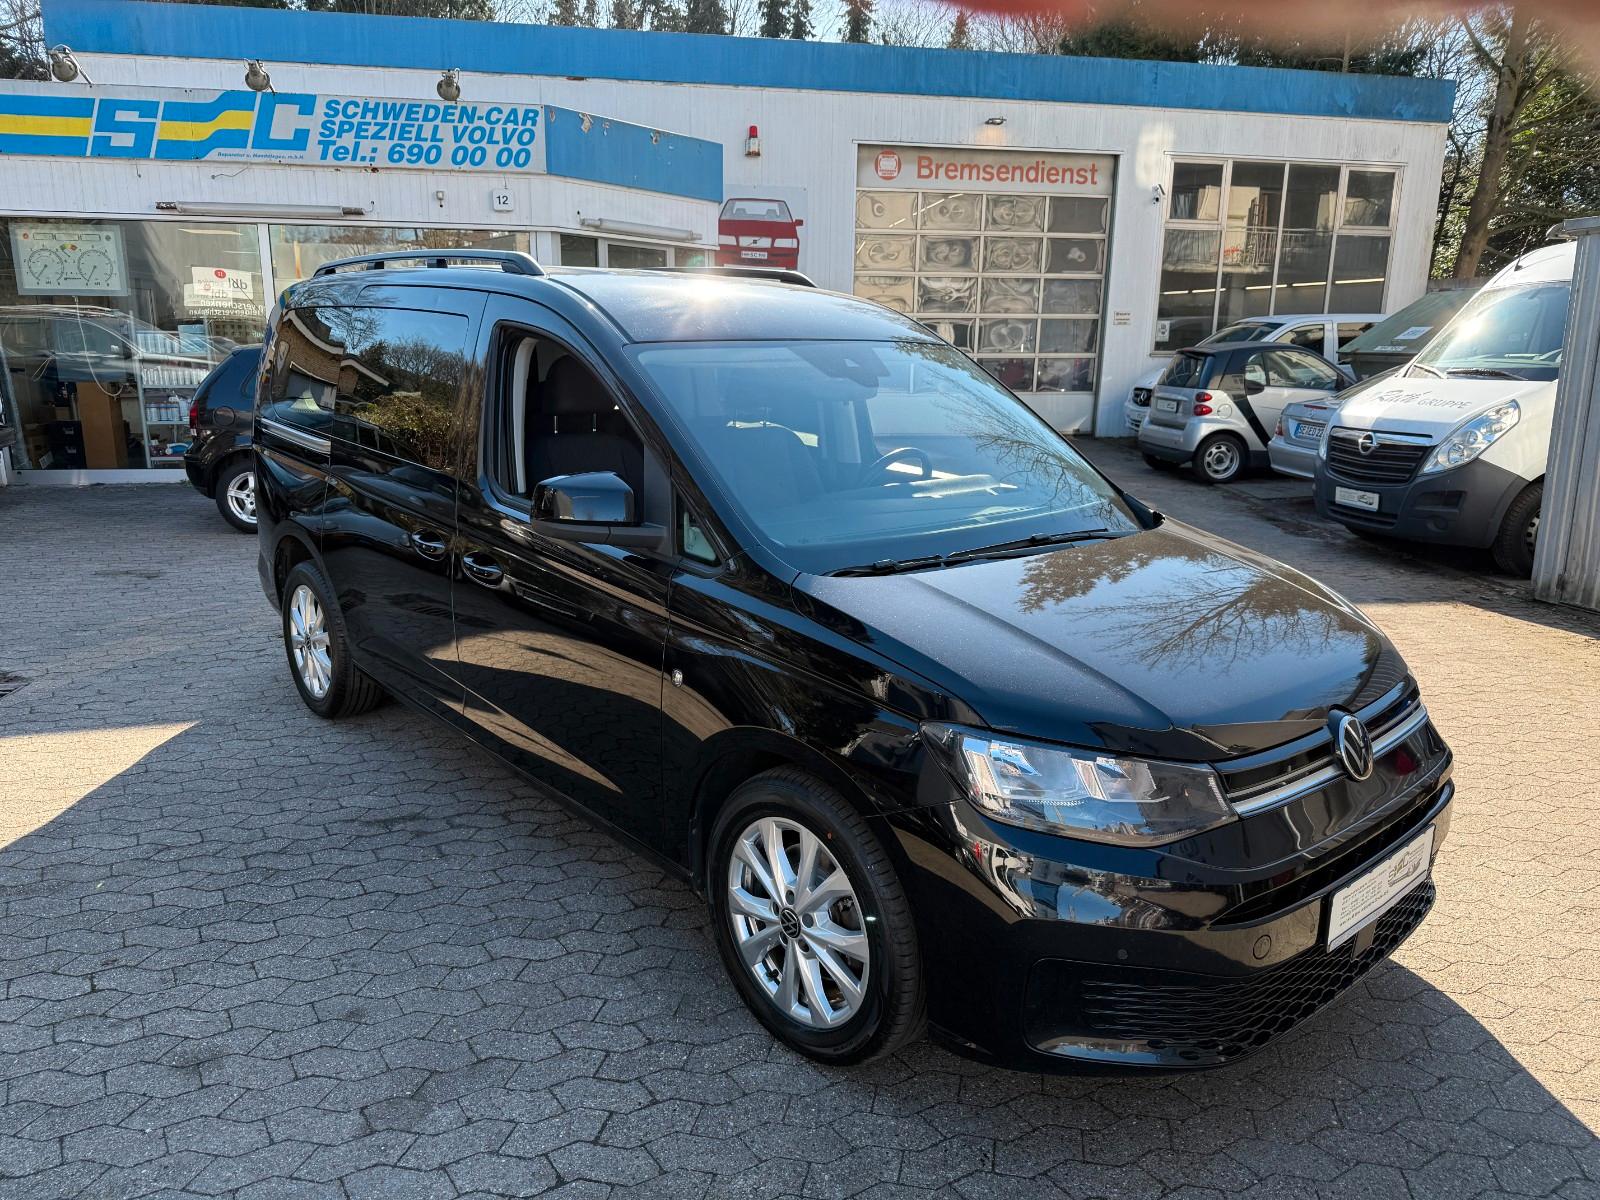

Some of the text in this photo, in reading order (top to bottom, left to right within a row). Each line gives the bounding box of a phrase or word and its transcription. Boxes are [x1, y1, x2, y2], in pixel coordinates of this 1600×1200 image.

[323, 99, 539, 127] SCHWEDEN-CAR
[319, 119, 536, 147] SPEZIELL VOLVO
[318, 139, 531, 168] Tel.: 690 00 00
[916, 155, 1098, 185] Bremsendienst
[496, 195, 509, 206] 12
